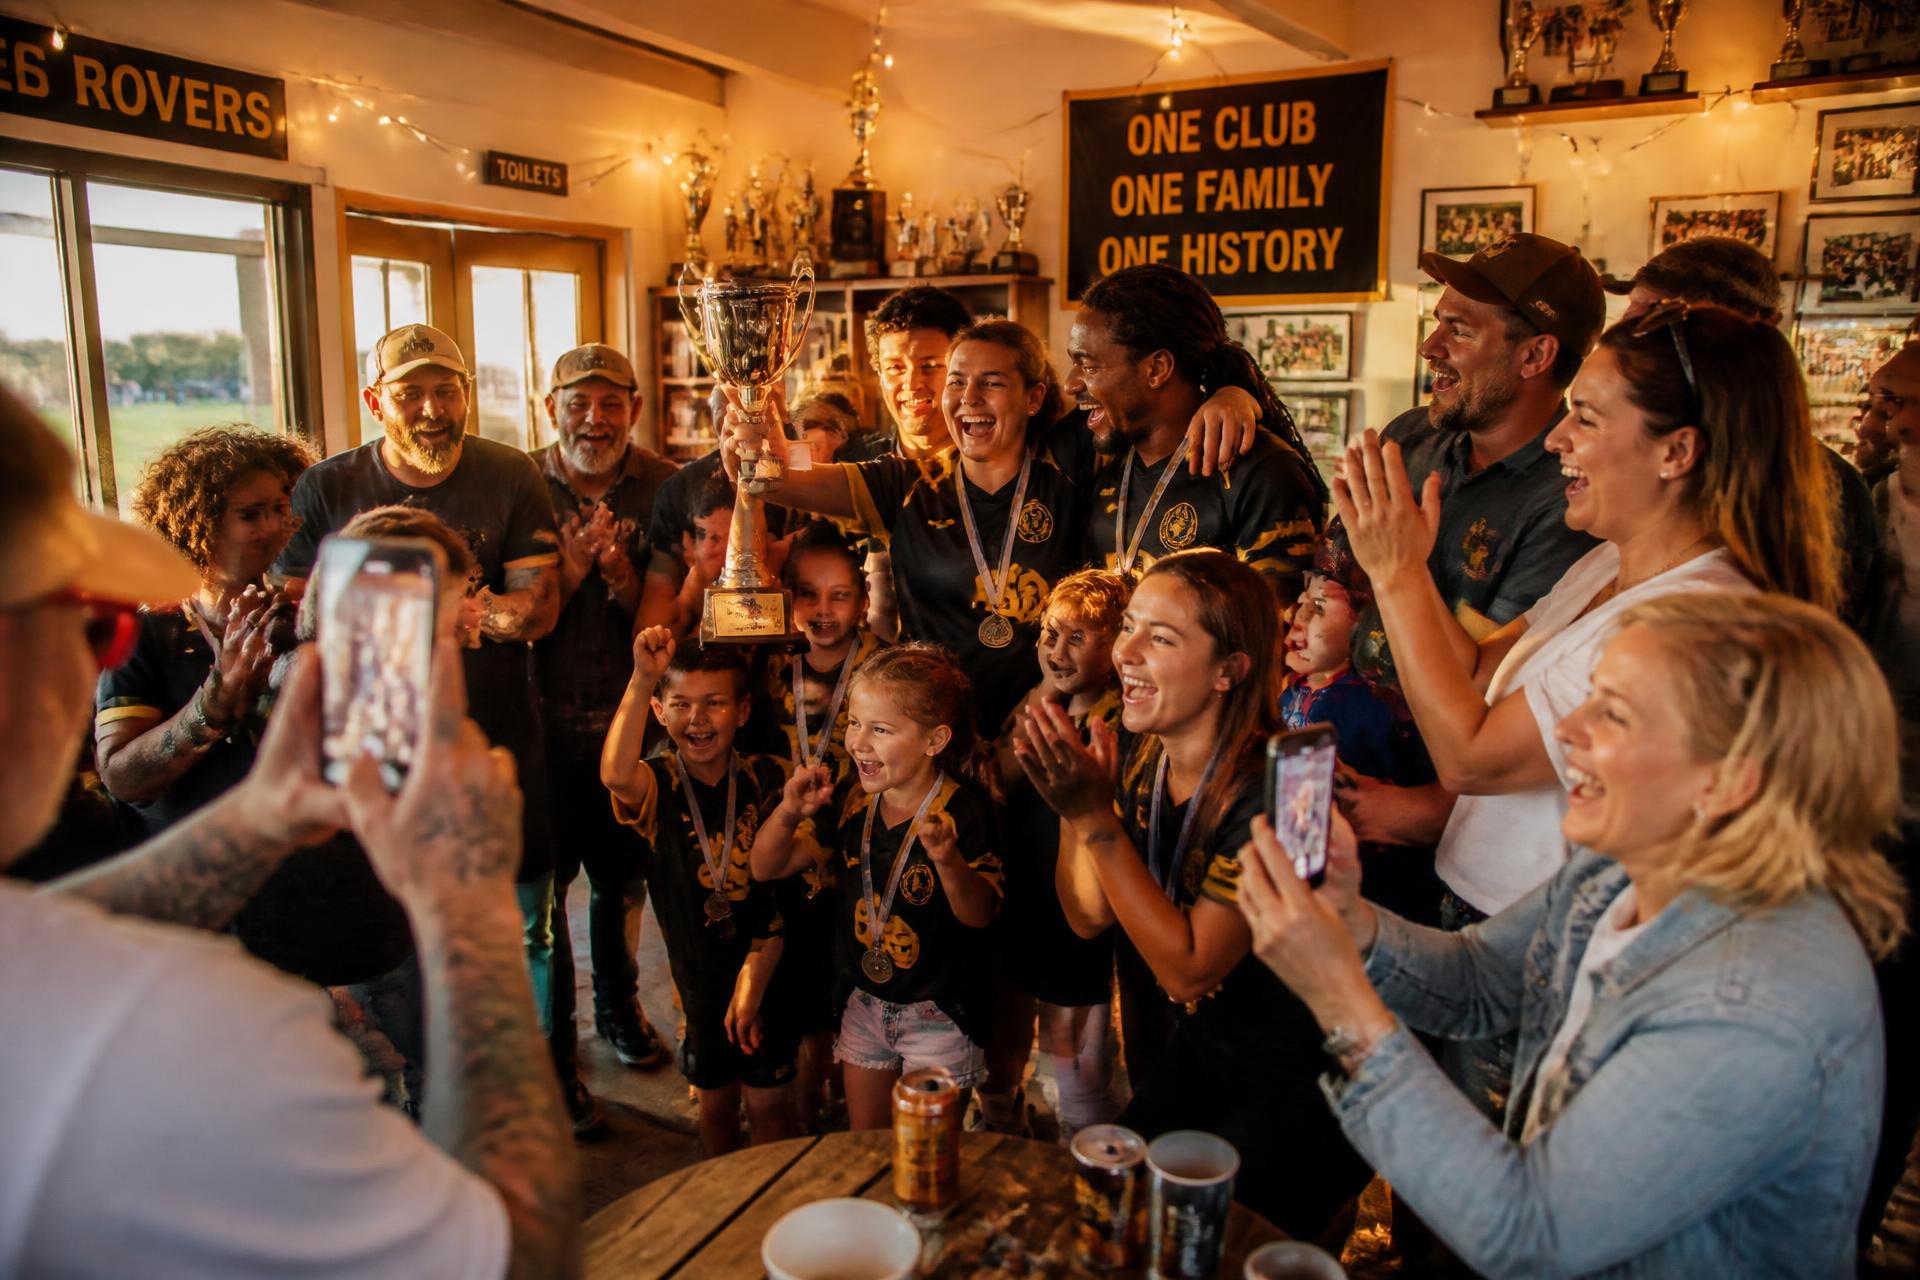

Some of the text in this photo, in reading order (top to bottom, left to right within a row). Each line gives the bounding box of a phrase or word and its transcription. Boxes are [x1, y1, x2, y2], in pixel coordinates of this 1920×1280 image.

[72, 55, 272, 139] ROVERS
[1127, 101, 1317, 156] ONE CLUB
[497, 159, 561, 188] TOILETS
[1111, 163, 1334, 217] ONE FAMILY
[1182, 227, 1344, 276] HISTORY
